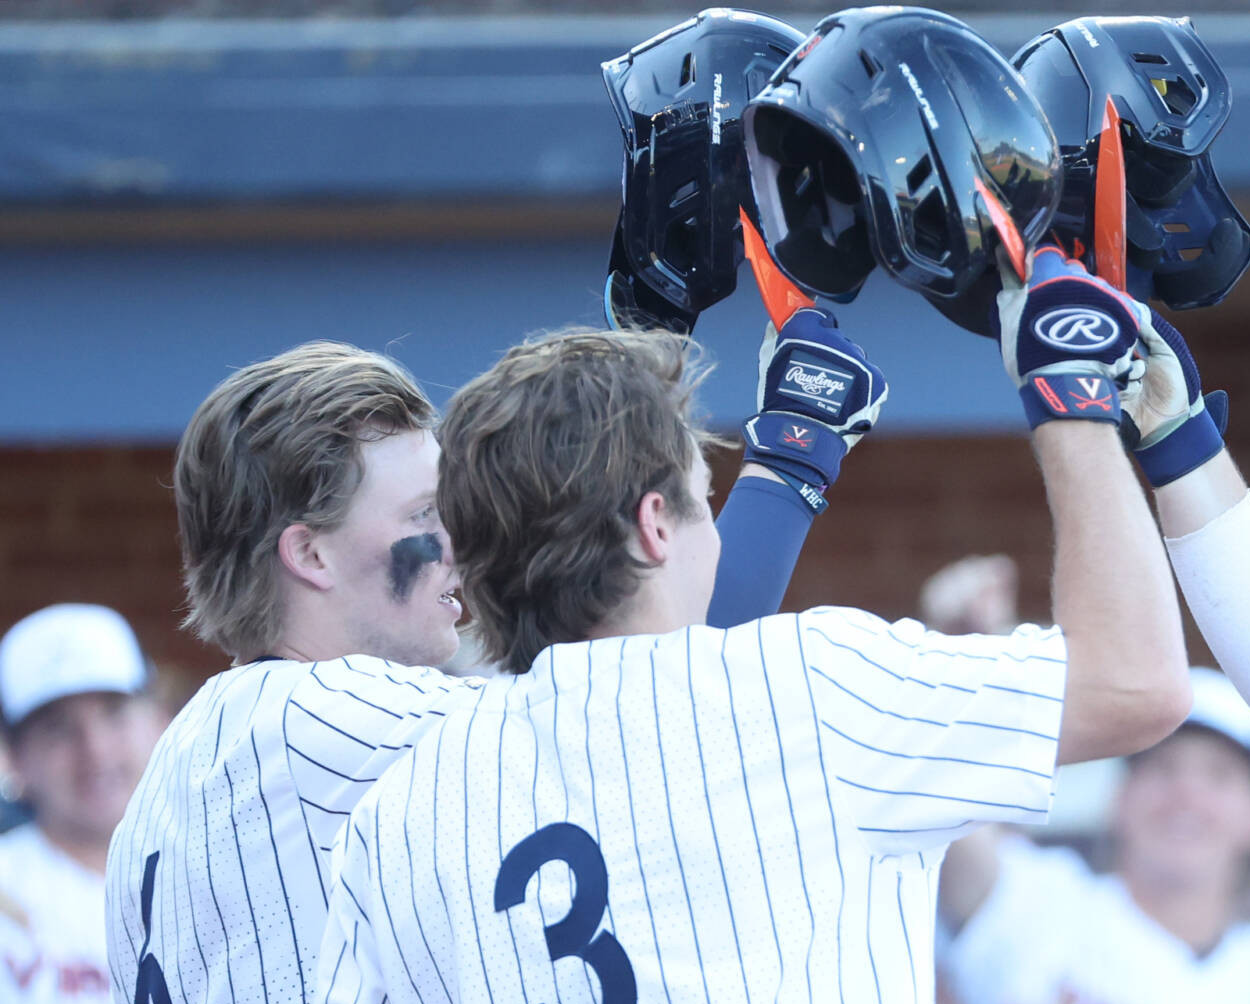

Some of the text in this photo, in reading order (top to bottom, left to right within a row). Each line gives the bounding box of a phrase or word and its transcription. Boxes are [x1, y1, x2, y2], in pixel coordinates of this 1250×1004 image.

[712, 73, 722, 145] RAWLINGS
[1048, 313, 1105, 342] R
[785, 366, 845, 395] Rawlings
[1076, 377, 1102, 400] V
[792, 425, 808, 439] V
[799, 483, 823, 509] WHC
